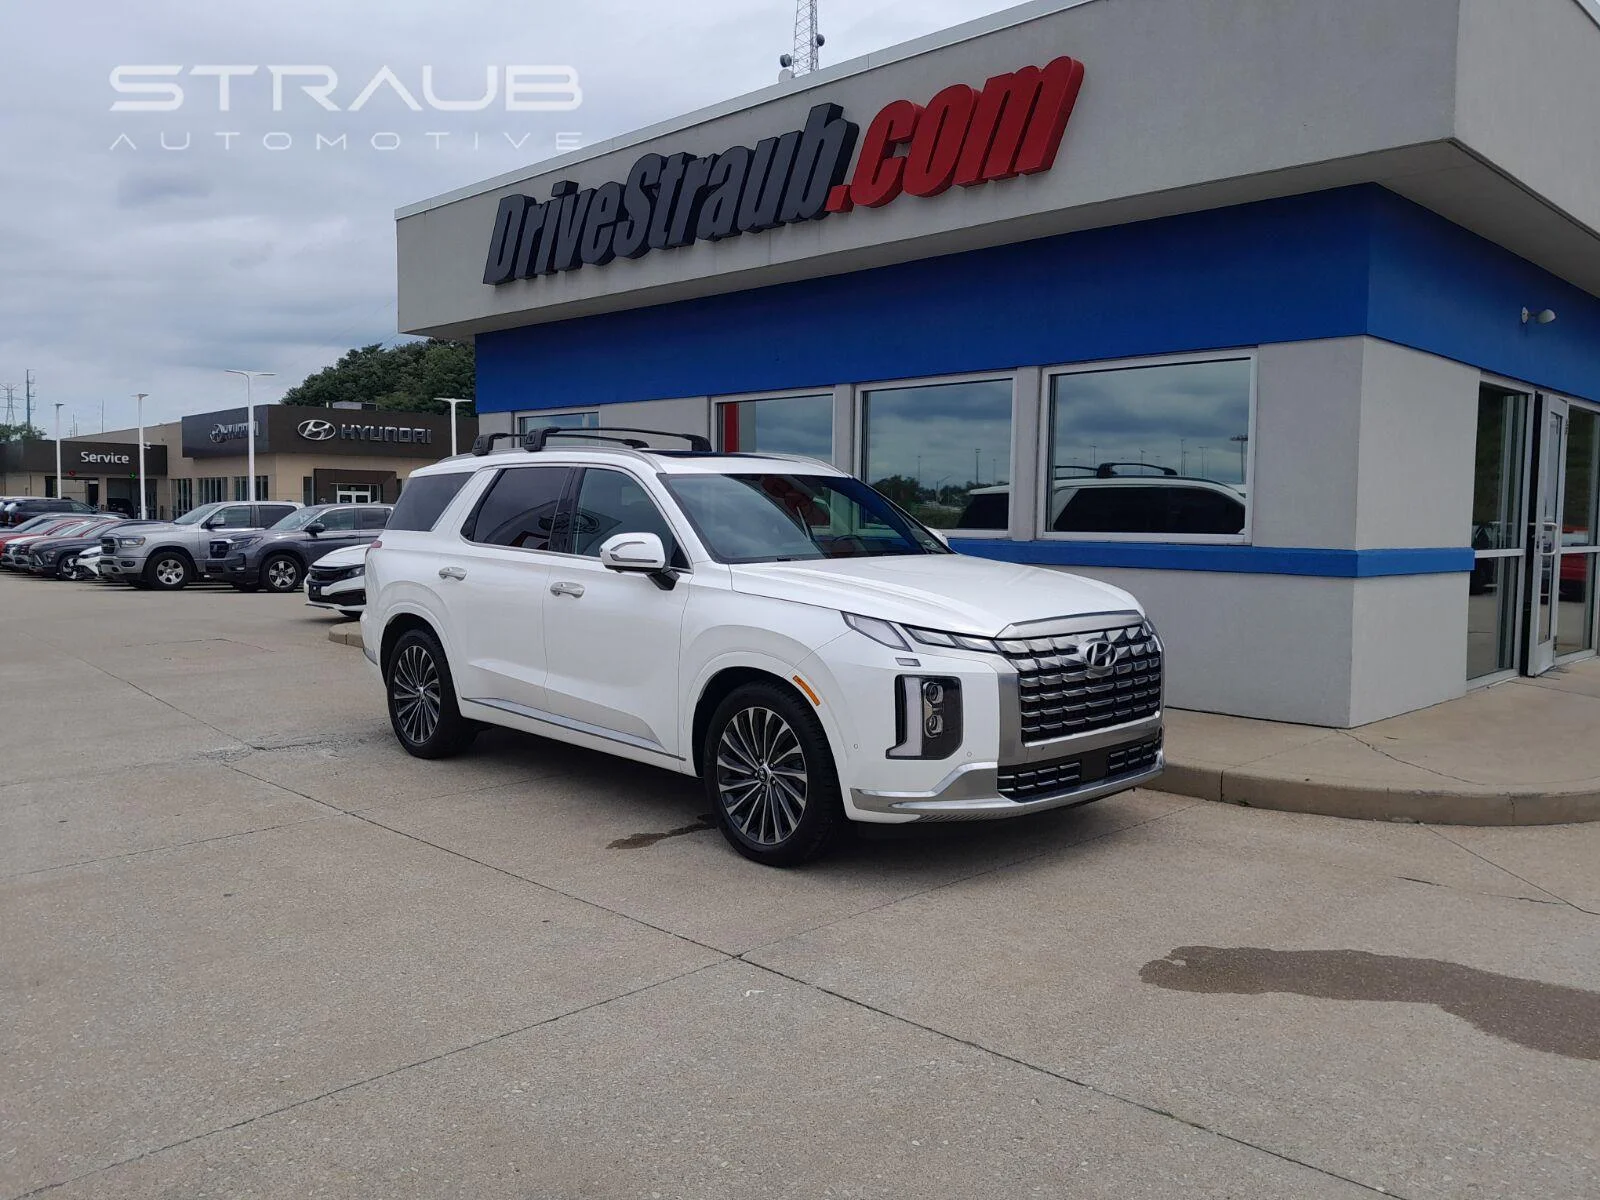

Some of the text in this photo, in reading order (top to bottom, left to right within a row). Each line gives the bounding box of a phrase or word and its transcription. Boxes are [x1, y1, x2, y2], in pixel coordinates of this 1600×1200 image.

[483, 55, 1085, 285] DriveStraub.com
[341, 423, 433, 443] HYUNDAI
[80, 451, 130, 464] Service
